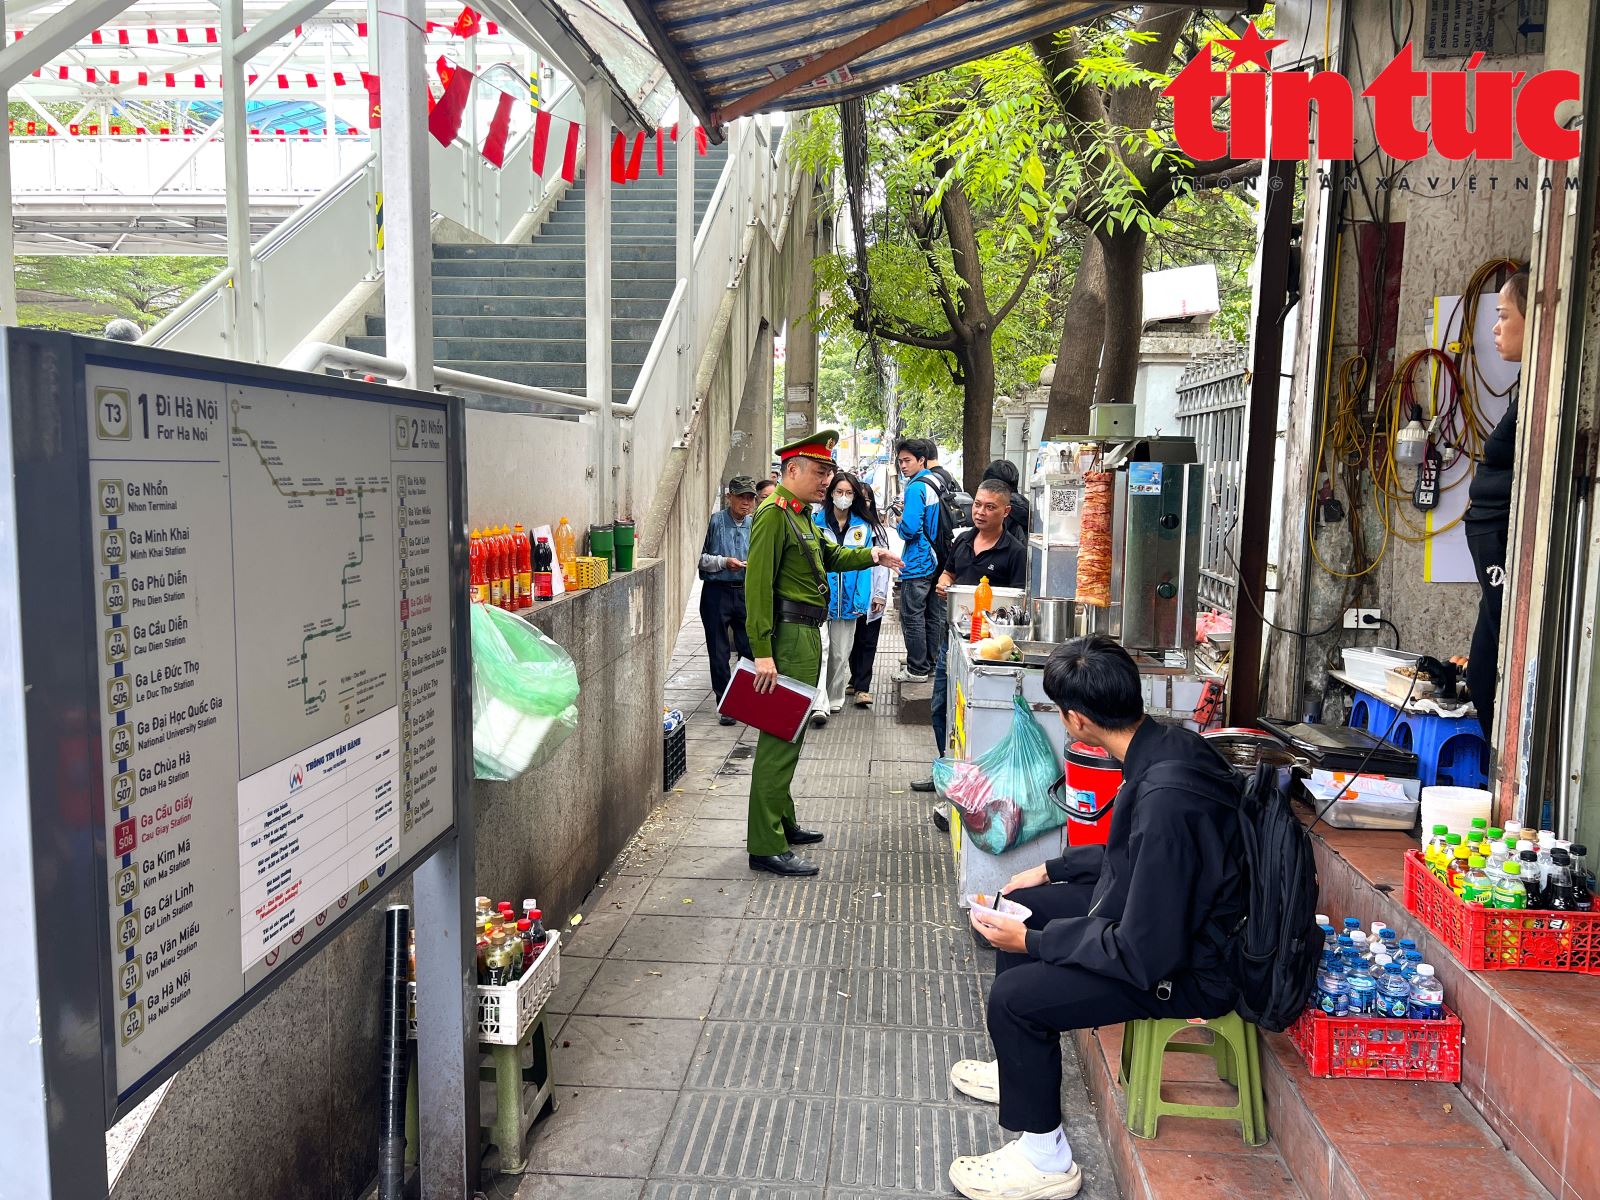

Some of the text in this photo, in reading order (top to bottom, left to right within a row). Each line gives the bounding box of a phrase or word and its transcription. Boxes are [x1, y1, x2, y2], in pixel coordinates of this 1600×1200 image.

[105, 403, 122, 423] T3
[138, 393, 150, 440] 1
[156, 394, 218, 425] Đi Hà Nội
[157, 425, 208, 442] For Ha Noi
[412, 419, 419, 448] 2
[107, 485, 116, 495] T3
[127, 480, 168, 496] Ga Nhổn
[105, 497, 119, 509] S01
[128, 501, 178, 512] Nhon Terminal
[109, 536, 117, 545] T3
[130, 527, 190, 544] Ga Minh Khai
[107, 546, 121, 558] S02
[130, 546, 186, 560] Minh Khai Station
[132, 570, 188, 591] Ga Phú Diễn
[111, 585, 120, 594] T3
[109, 595, 123, 607] S03
[132, 591, 185, 608] Phu Dien Station
[133, 615, 188, 640] Ga Cầu Diễn
[113, 633, 122, 643] T3
[134, 635, 186, 655] Cau Dien Station
[111, 643, 126, 656] S04
[136, 661, 200, 688] Ga Lê Đức Thọ
[116, 683, 124, 692] T3
[136, 678, 195, 703] Le Duc Tho Station
[113, 692, 128, 705] S05
[137, 697, 223, 736] Ga Đại Học Quốc Gia
[118, 731, 126, 741] T3
[138, 716, 217, 751] National University Station
[115, 741, 130, 754] S06
[139, 751, 191, 782] Ga Chùa Hà
[119, 779, 128, 789] T3
[139, 770, 190, 797] Chua Ha Station
[116, 787, 131, 802] S07
[141, 793, 194, 828] Ga Cầu Giấy
[121, 826, 129, 836] T3
[141, 813, 191, 843] Cau Giay Station
[118, 834, 133, 850] S08
[142, 838, 191, 874] Ga Kim Mã
[123, 872, 131, 882] T3
[143, 858, 191, 889] Kim Ma Station
[120, 881, 135, 896] S09
[144, 882, 194, 919] Ga Cát Linh
[125, 920, 133, 930] T3
[144, 901, 193, 935] Cat Linh Station
[122, 928, 136, 943] S10
[145, 920, 200, 965] Ga Văn Miếu
[146, 941, 198, 980] Van Mieu Station
[127, 965, 135, 976] T3
[125, 975, 137, 990] S11
[147, 968, 191, 1009] Ga Hà Nội
[148, 988, 191, 1025] Ha Noi Station
[128, 1010, 137, 1022] T3
[126, 1021, 139, 1036] S12
